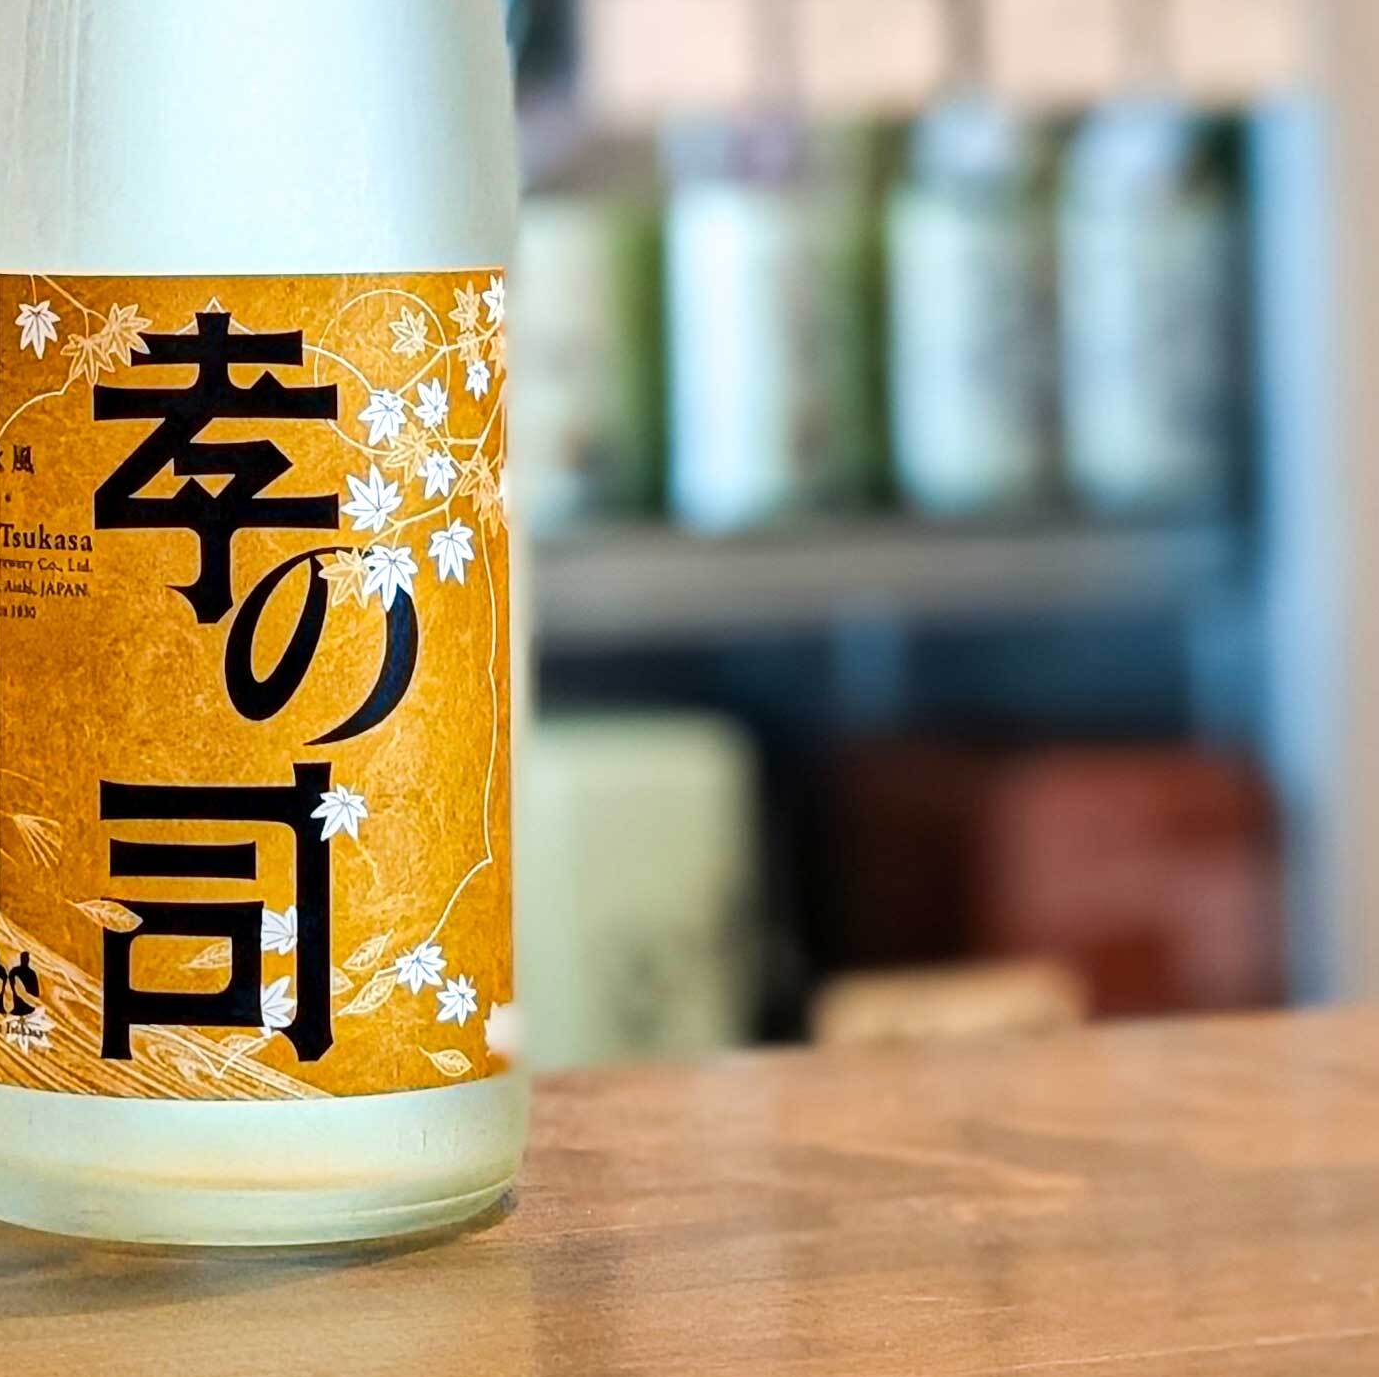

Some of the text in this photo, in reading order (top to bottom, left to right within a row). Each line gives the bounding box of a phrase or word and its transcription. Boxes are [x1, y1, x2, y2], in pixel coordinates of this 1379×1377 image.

[0, 523, 94, 552] Tsukasa
[93, 310, 420, 1063] 孝の司
